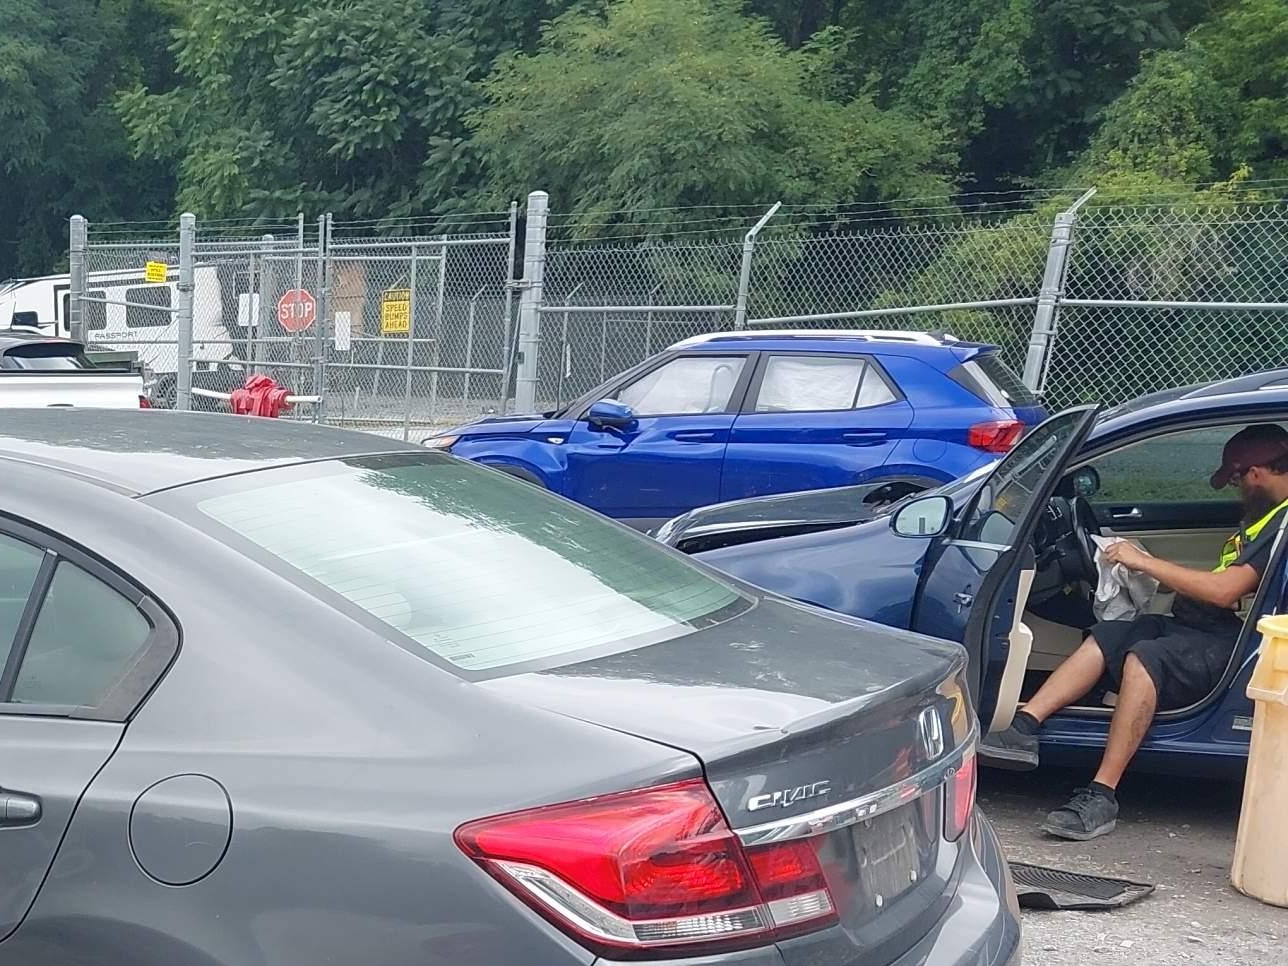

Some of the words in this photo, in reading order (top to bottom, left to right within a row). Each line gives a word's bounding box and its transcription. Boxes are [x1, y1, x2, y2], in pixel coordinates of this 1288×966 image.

[281, 302, 313, 319] STOP
[385, 303, 408, 312] SPEED
[384, 321, 408, 330] AHEAD
[747, 779, 832, 812] CIVIC
